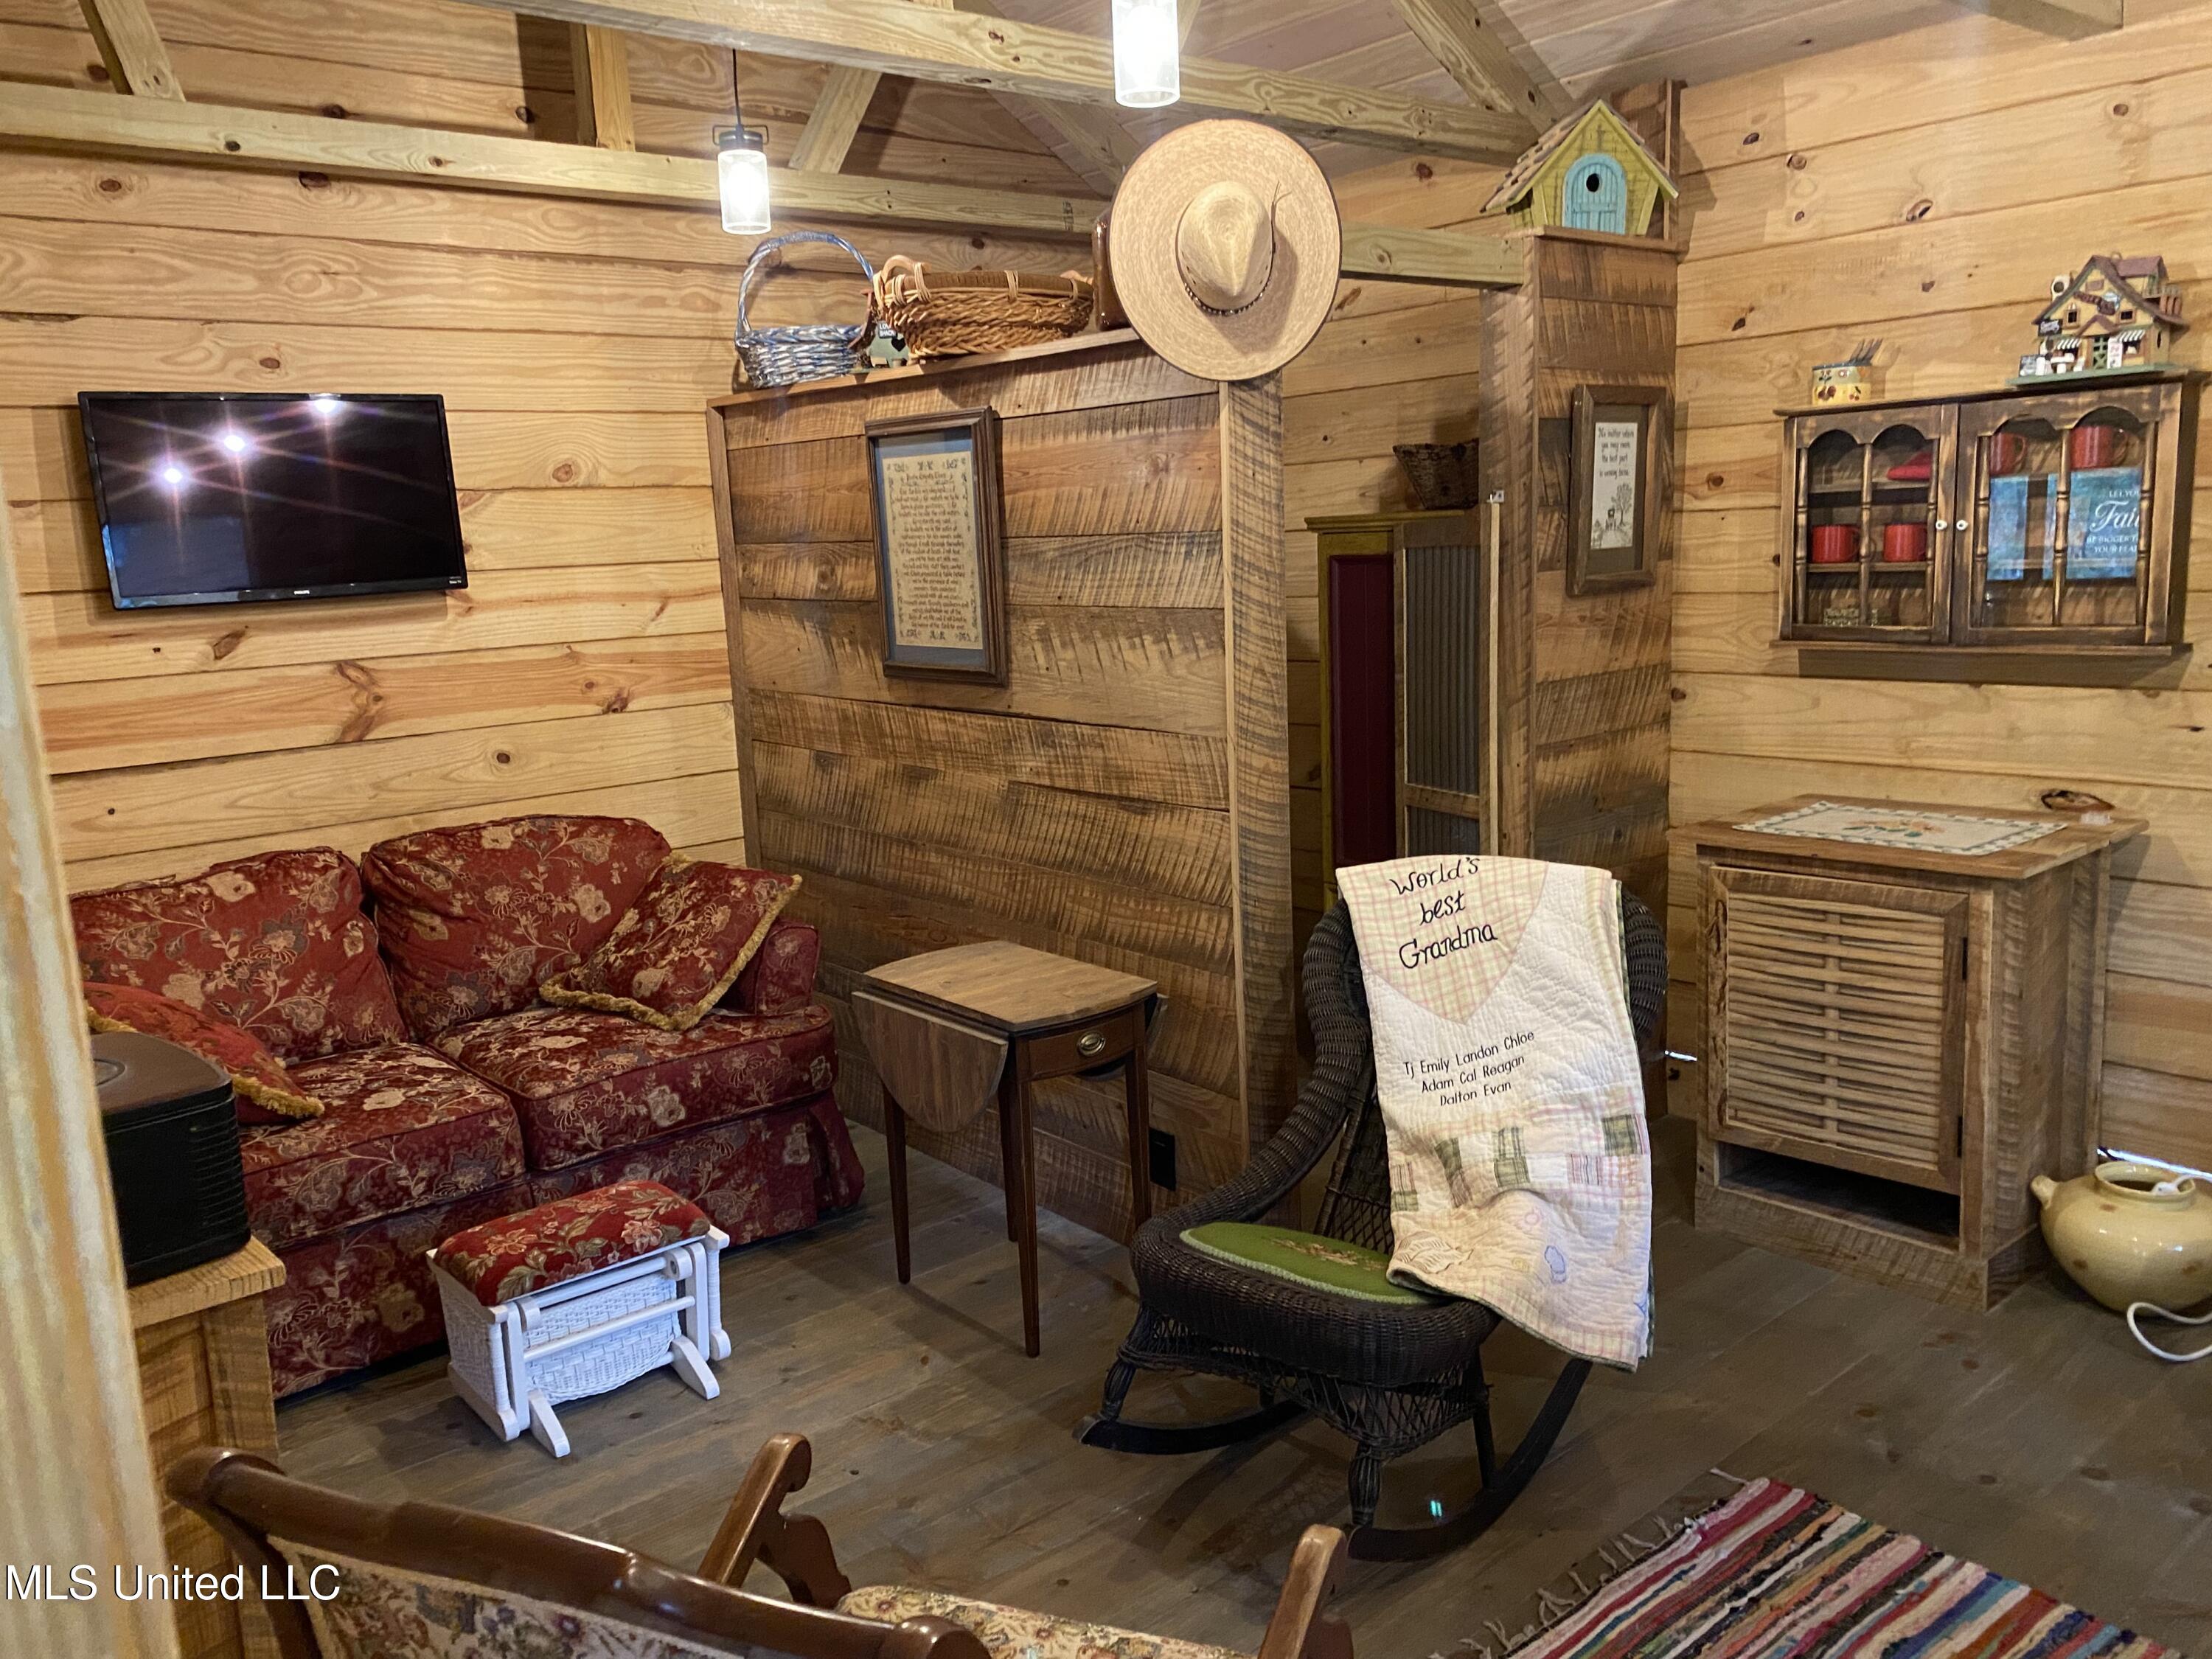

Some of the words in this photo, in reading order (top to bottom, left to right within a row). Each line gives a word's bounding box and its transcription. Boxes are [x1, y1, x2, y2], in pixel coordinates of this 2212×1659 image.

[2125, 488, 2140, 497] YOU
[2090, 500, 2140, 532] Fai
[1389, 856, 1481, 896] World's
[1419, 889, 1467, 926] best
[1398, 922, 1498, 970] Grandma
[1403, 1060, 1414, 1079] Tj
[1420, 1057, 1450, 1074] Emily
[1455, 1044, 1499, 1066] Landon
[1503, 1032, 1534, 1051] Chloe
[1422, 1079, 1454, 1093] Adam
[1459, 1068, 1477, 1085] Cal
[1483, 1055, 1525, 1078] Reagan
[1440, 1090, 1478, 1106] Dalton
[1484, 1081, 1512, 1096] Evan
